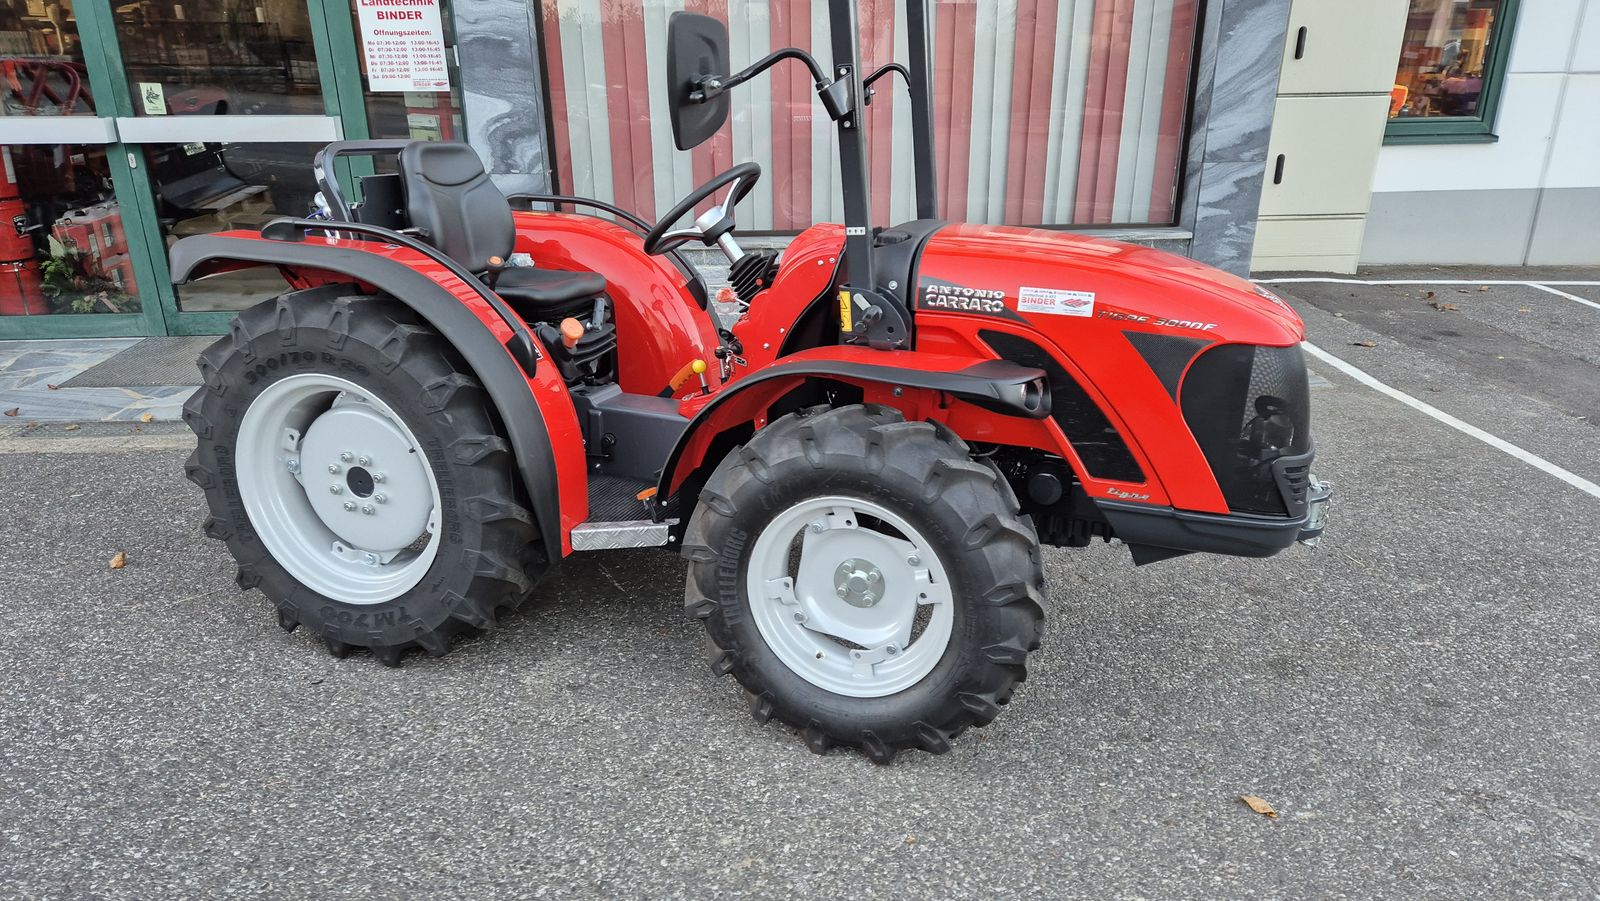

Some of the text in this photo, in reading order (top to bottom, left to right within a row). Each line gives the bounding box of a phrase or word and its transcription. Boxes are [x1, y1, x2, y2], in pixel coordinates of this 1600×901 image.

[377, 11, 423, 20] BINDER
[926, 284, 1006, 299] ANTONIO
[925, 293, 1005, 313] CARRARO
[1021, 297, 1056, 306] BINDER
[718, 526, 749, 627] TRELLEBORG
